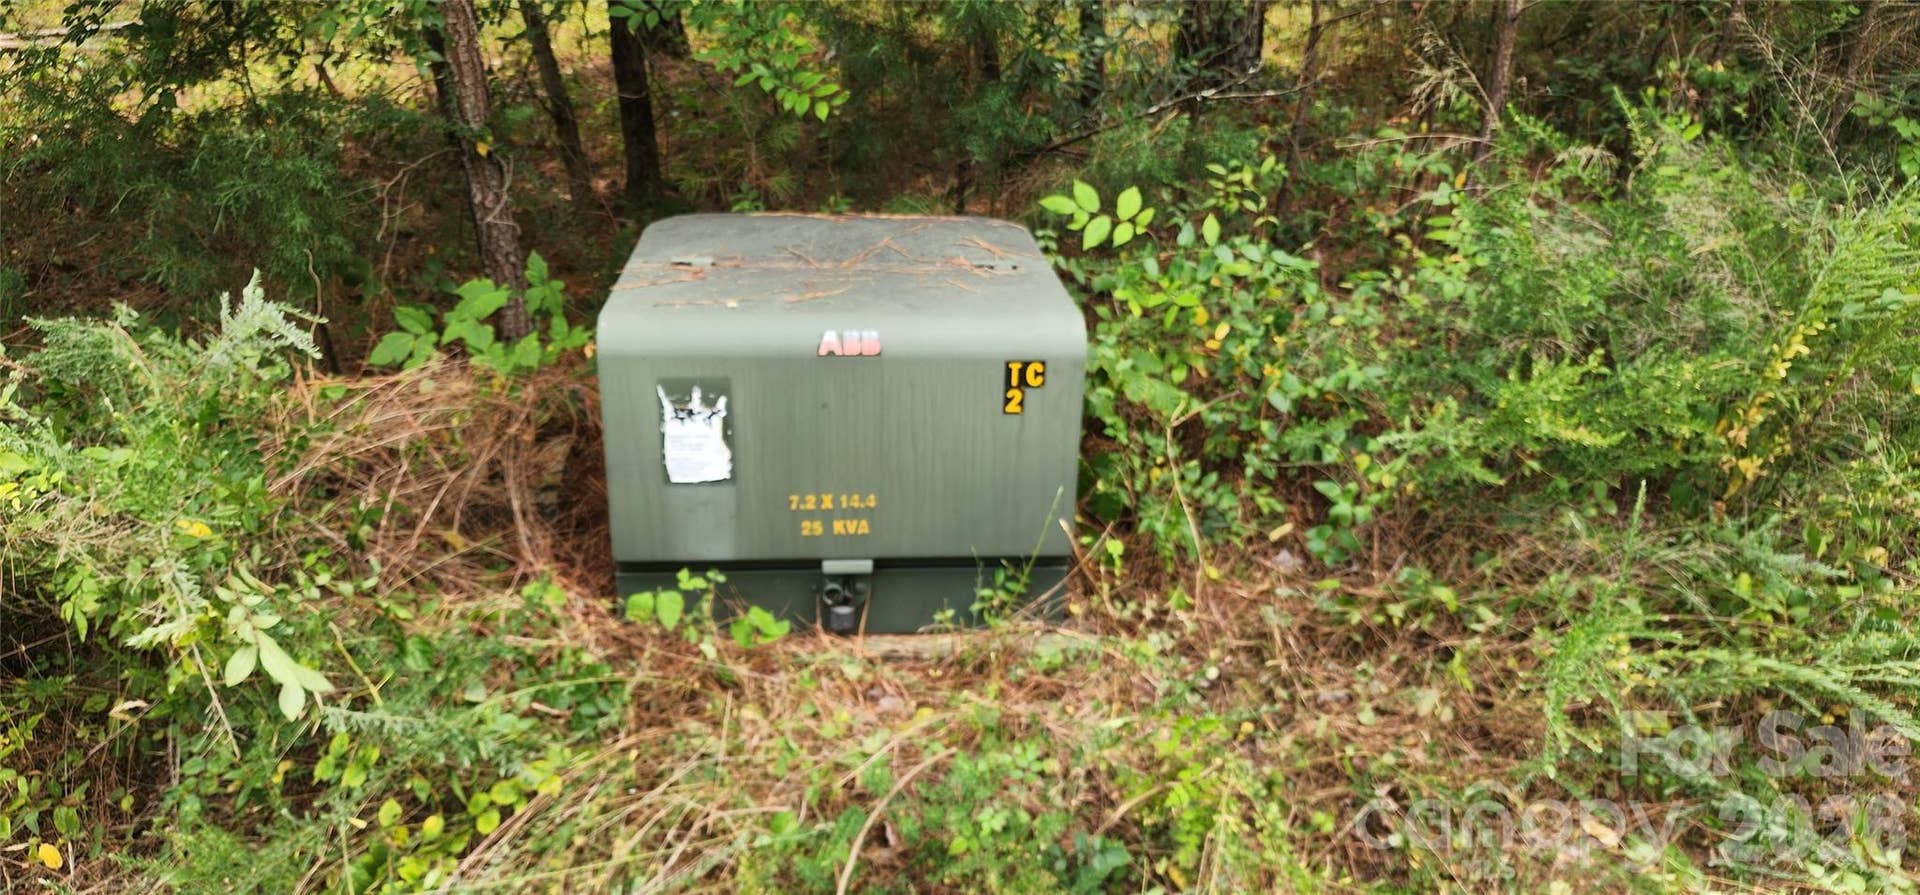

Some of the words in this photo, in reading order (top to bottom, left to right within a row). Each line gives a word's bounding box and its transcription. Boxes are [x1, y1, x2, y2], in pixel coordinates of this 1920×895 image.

[817, 329, 882, 357] ABB
[1008, 362, 1045, 388] TC
[1004, 389, 1024, 414] 2
[789, 495, 817, 510] 7.2
[840, 493, 877, 509] 14.4
[800, 520, 824, 536] 25
[833, 519, 870, 535] KVA
